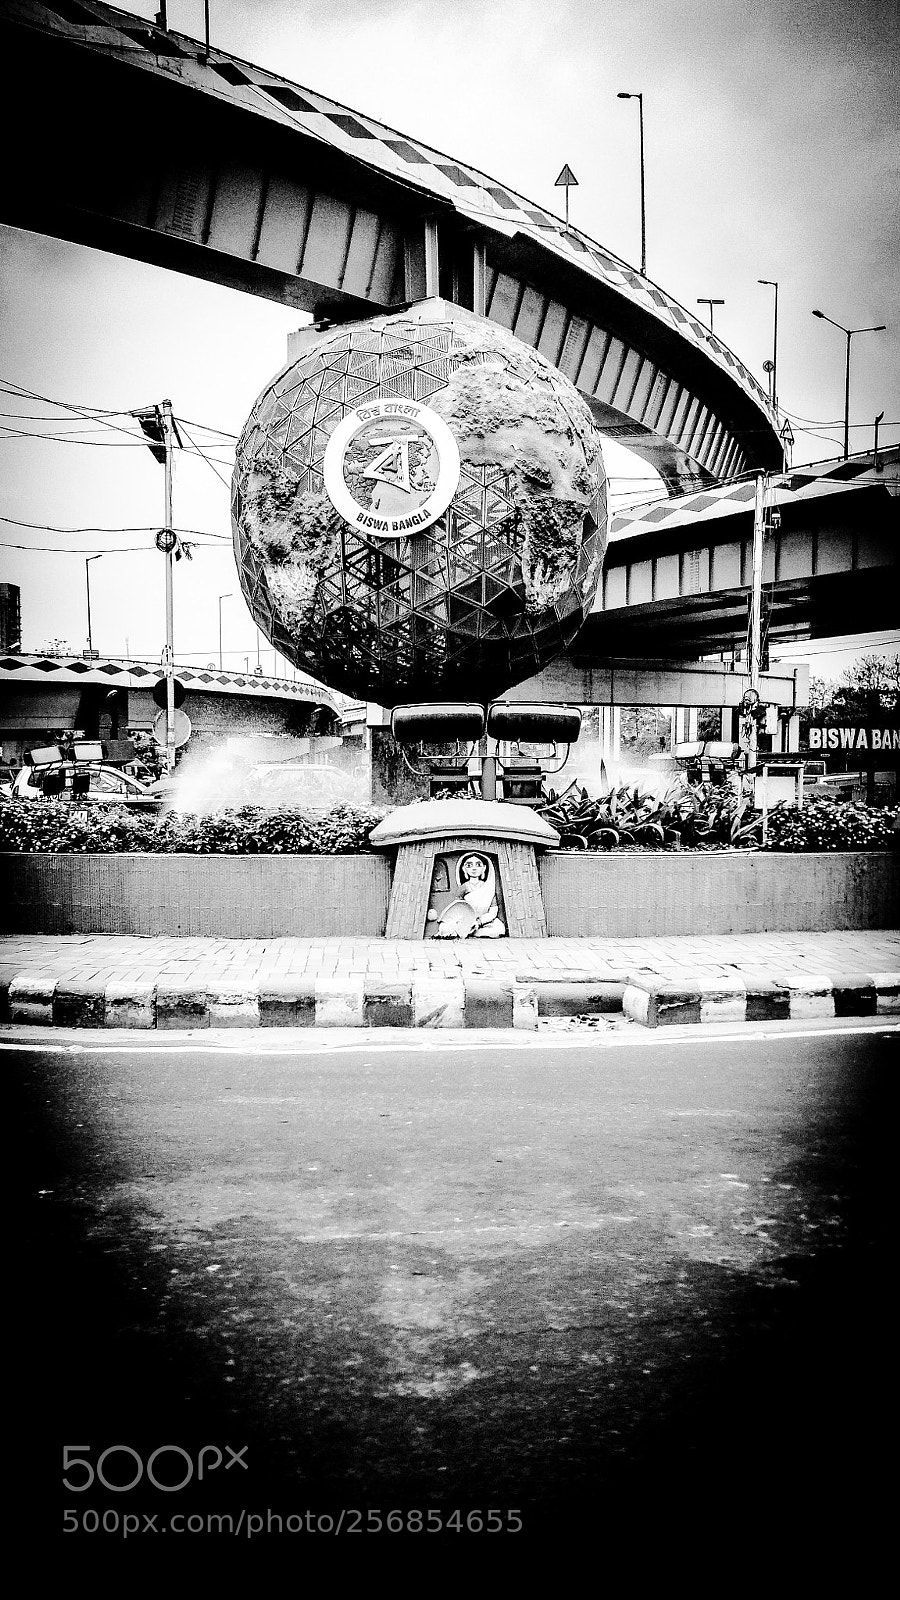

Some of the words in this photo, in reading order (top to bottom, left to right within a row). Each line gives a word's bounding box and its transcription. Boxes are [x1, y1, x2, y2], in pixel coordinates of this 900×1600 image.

[384, 403, 421, 418] বাংলা
[356, 512, 389, 531] BISWA
[392, 509, 431, 531] BANGLA
[809, 728, 868, 749] BISWA
[871, 729, 900, 749] BAN
